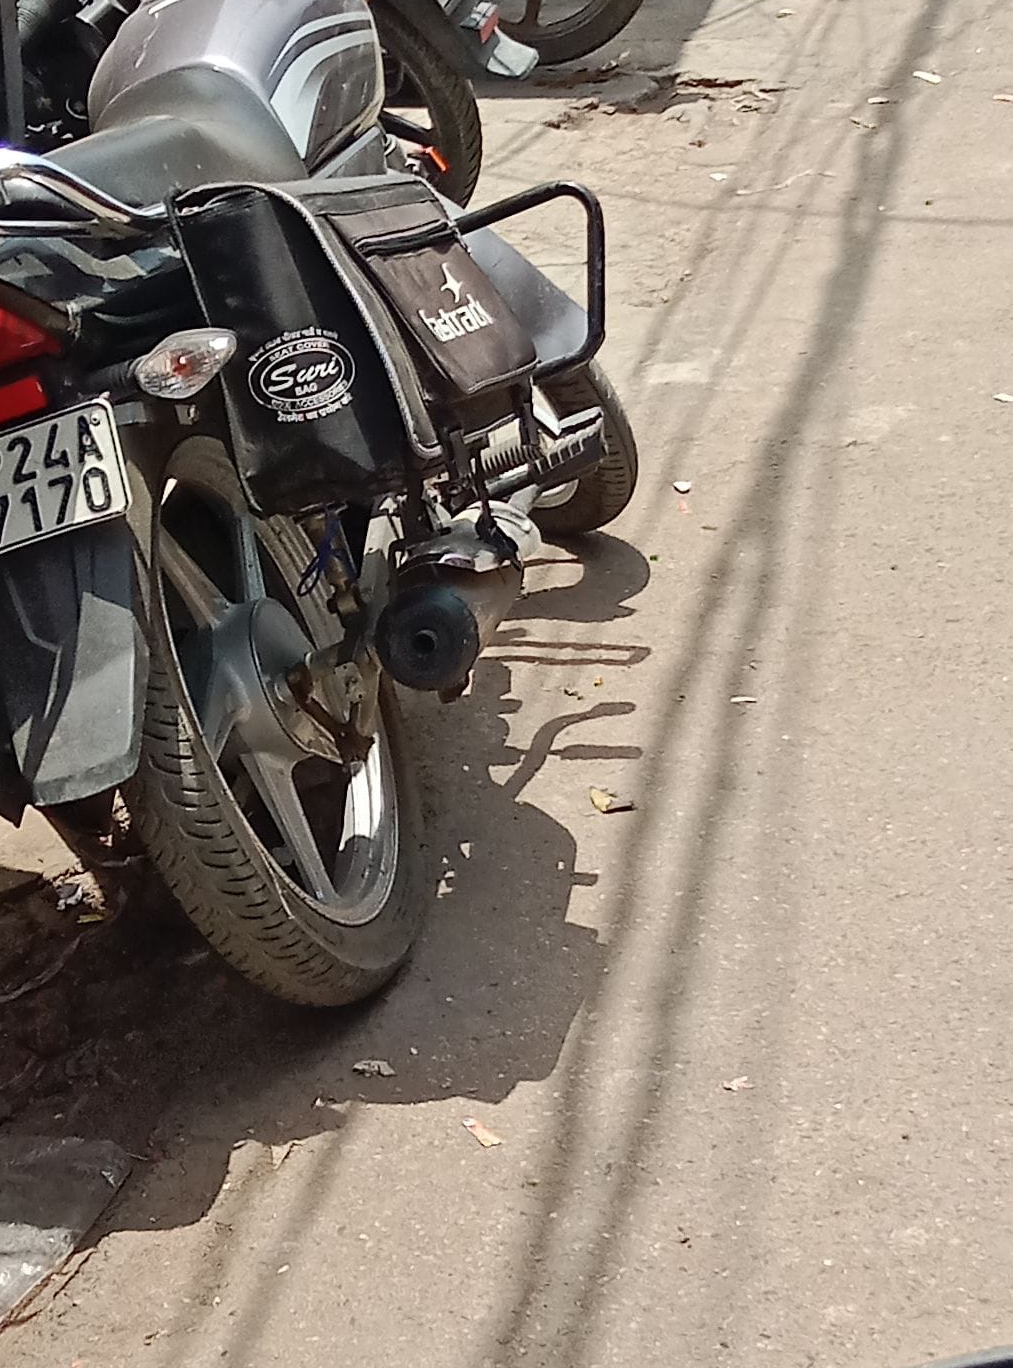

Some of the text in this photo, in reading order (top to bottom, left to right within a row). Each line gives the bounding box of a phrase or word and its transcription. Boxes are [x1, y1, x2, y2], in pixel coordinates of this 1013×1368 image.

[268, 346, 293, 362] SEAT
[296, 340, 331, 351] COVER
[268, 356, 339, 392] Suri
[294, 382, 318, 396] BAG
